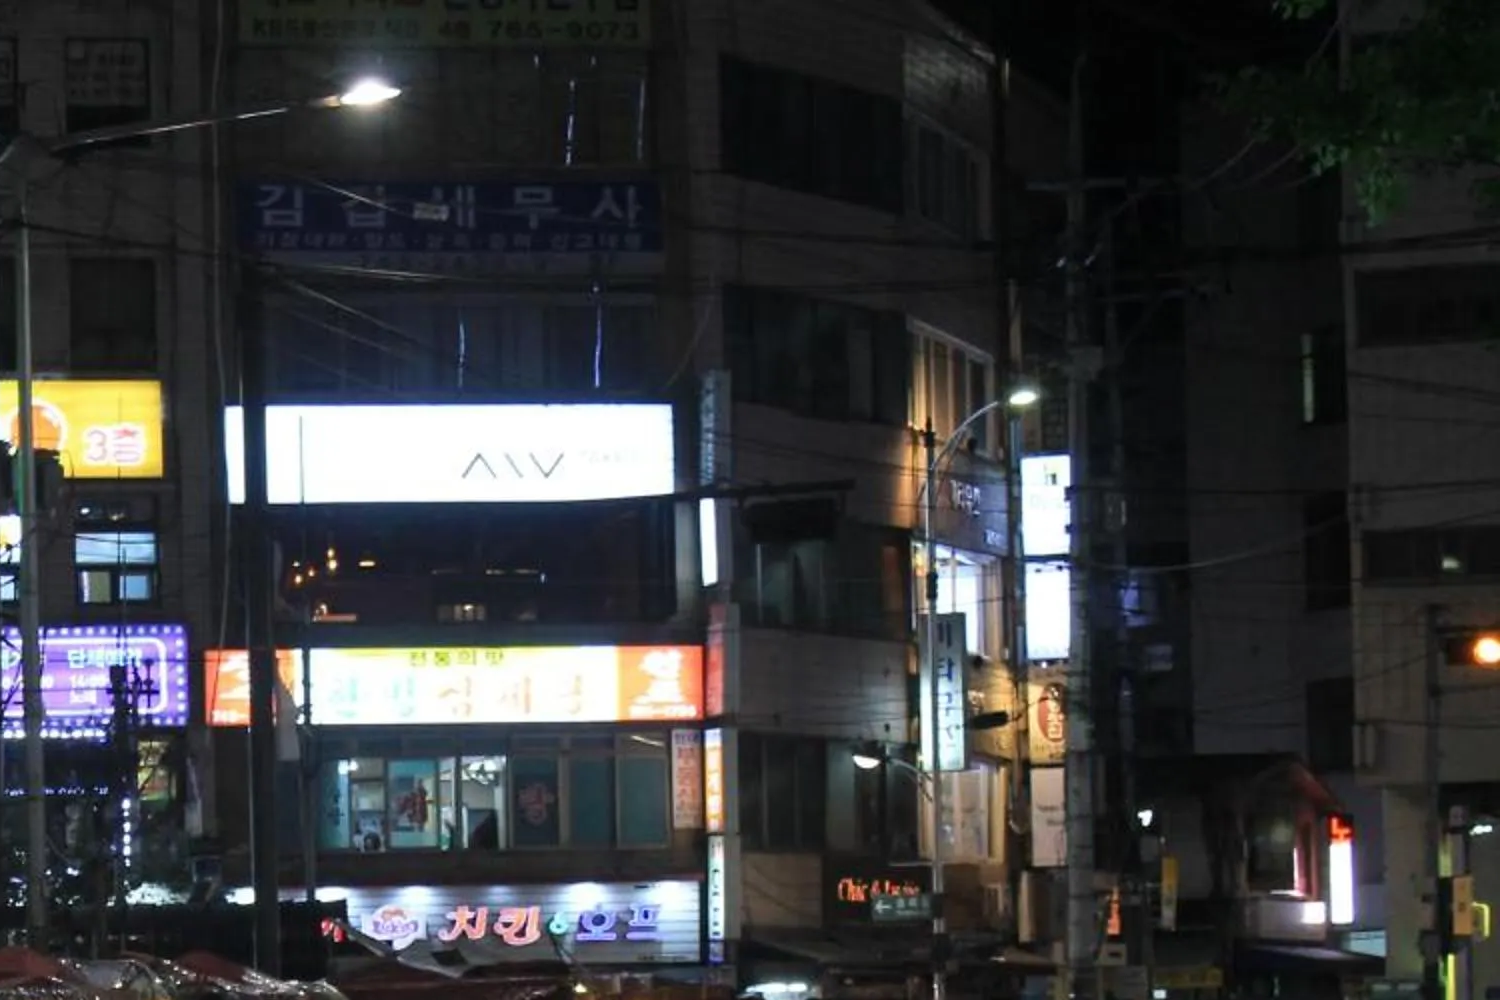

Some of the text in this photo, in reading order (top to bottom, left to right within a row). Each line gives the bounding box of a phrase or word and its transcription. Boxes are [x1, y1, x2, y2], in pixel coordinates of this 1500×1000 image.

[84, 425, 142, 464] 3층
[441, 905, 541, 945] 치킨
[577, 904, 662, 942] 호프
